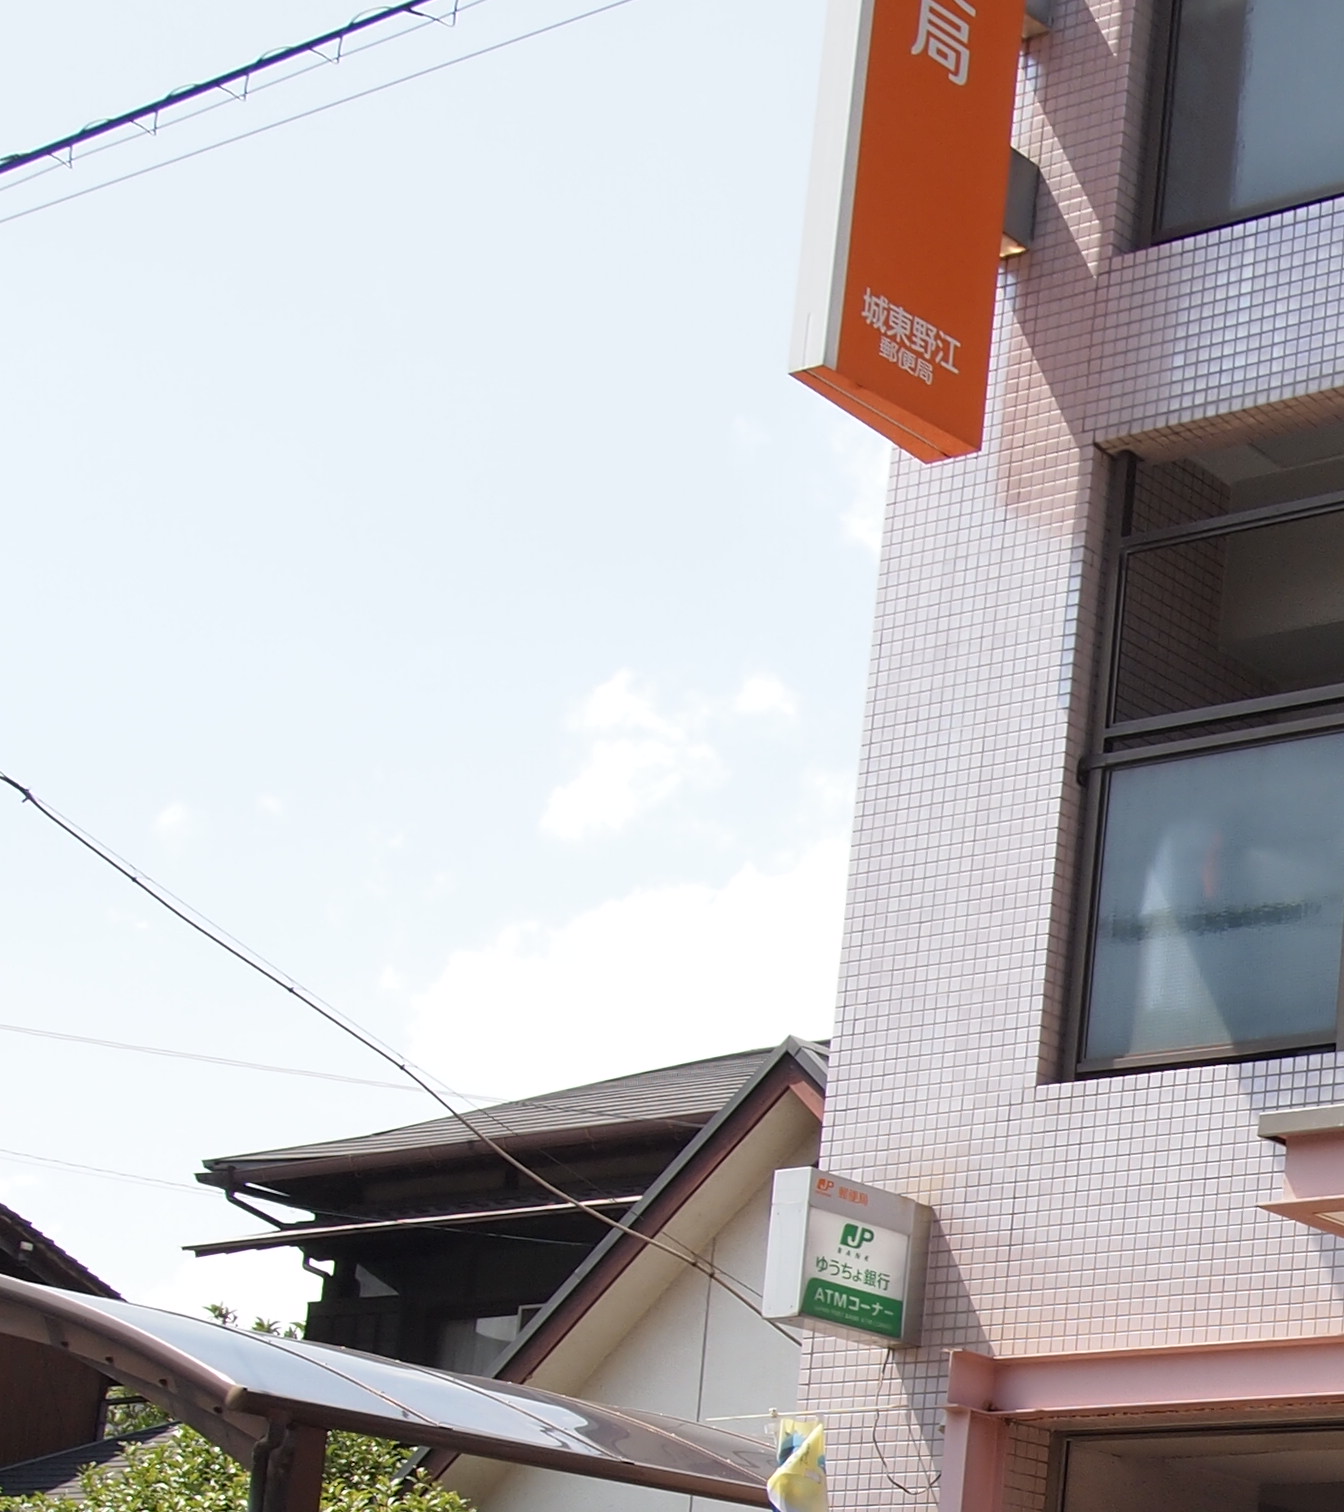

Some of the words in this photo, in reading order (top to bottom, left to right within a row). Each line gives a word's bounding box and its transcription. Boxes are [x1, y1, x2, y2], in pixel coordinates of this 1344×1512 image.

[911, 0, 977, 86] 局
[862, 287, 962, 375] 城東野江
[878, 335, 934, 386] 郵便局
[840, 1223, 875, 1249] JP
[815, 1256, 891, 1291] ゆうちょ銀行
[814, 1288, 894, 1316] ATMコーナー
